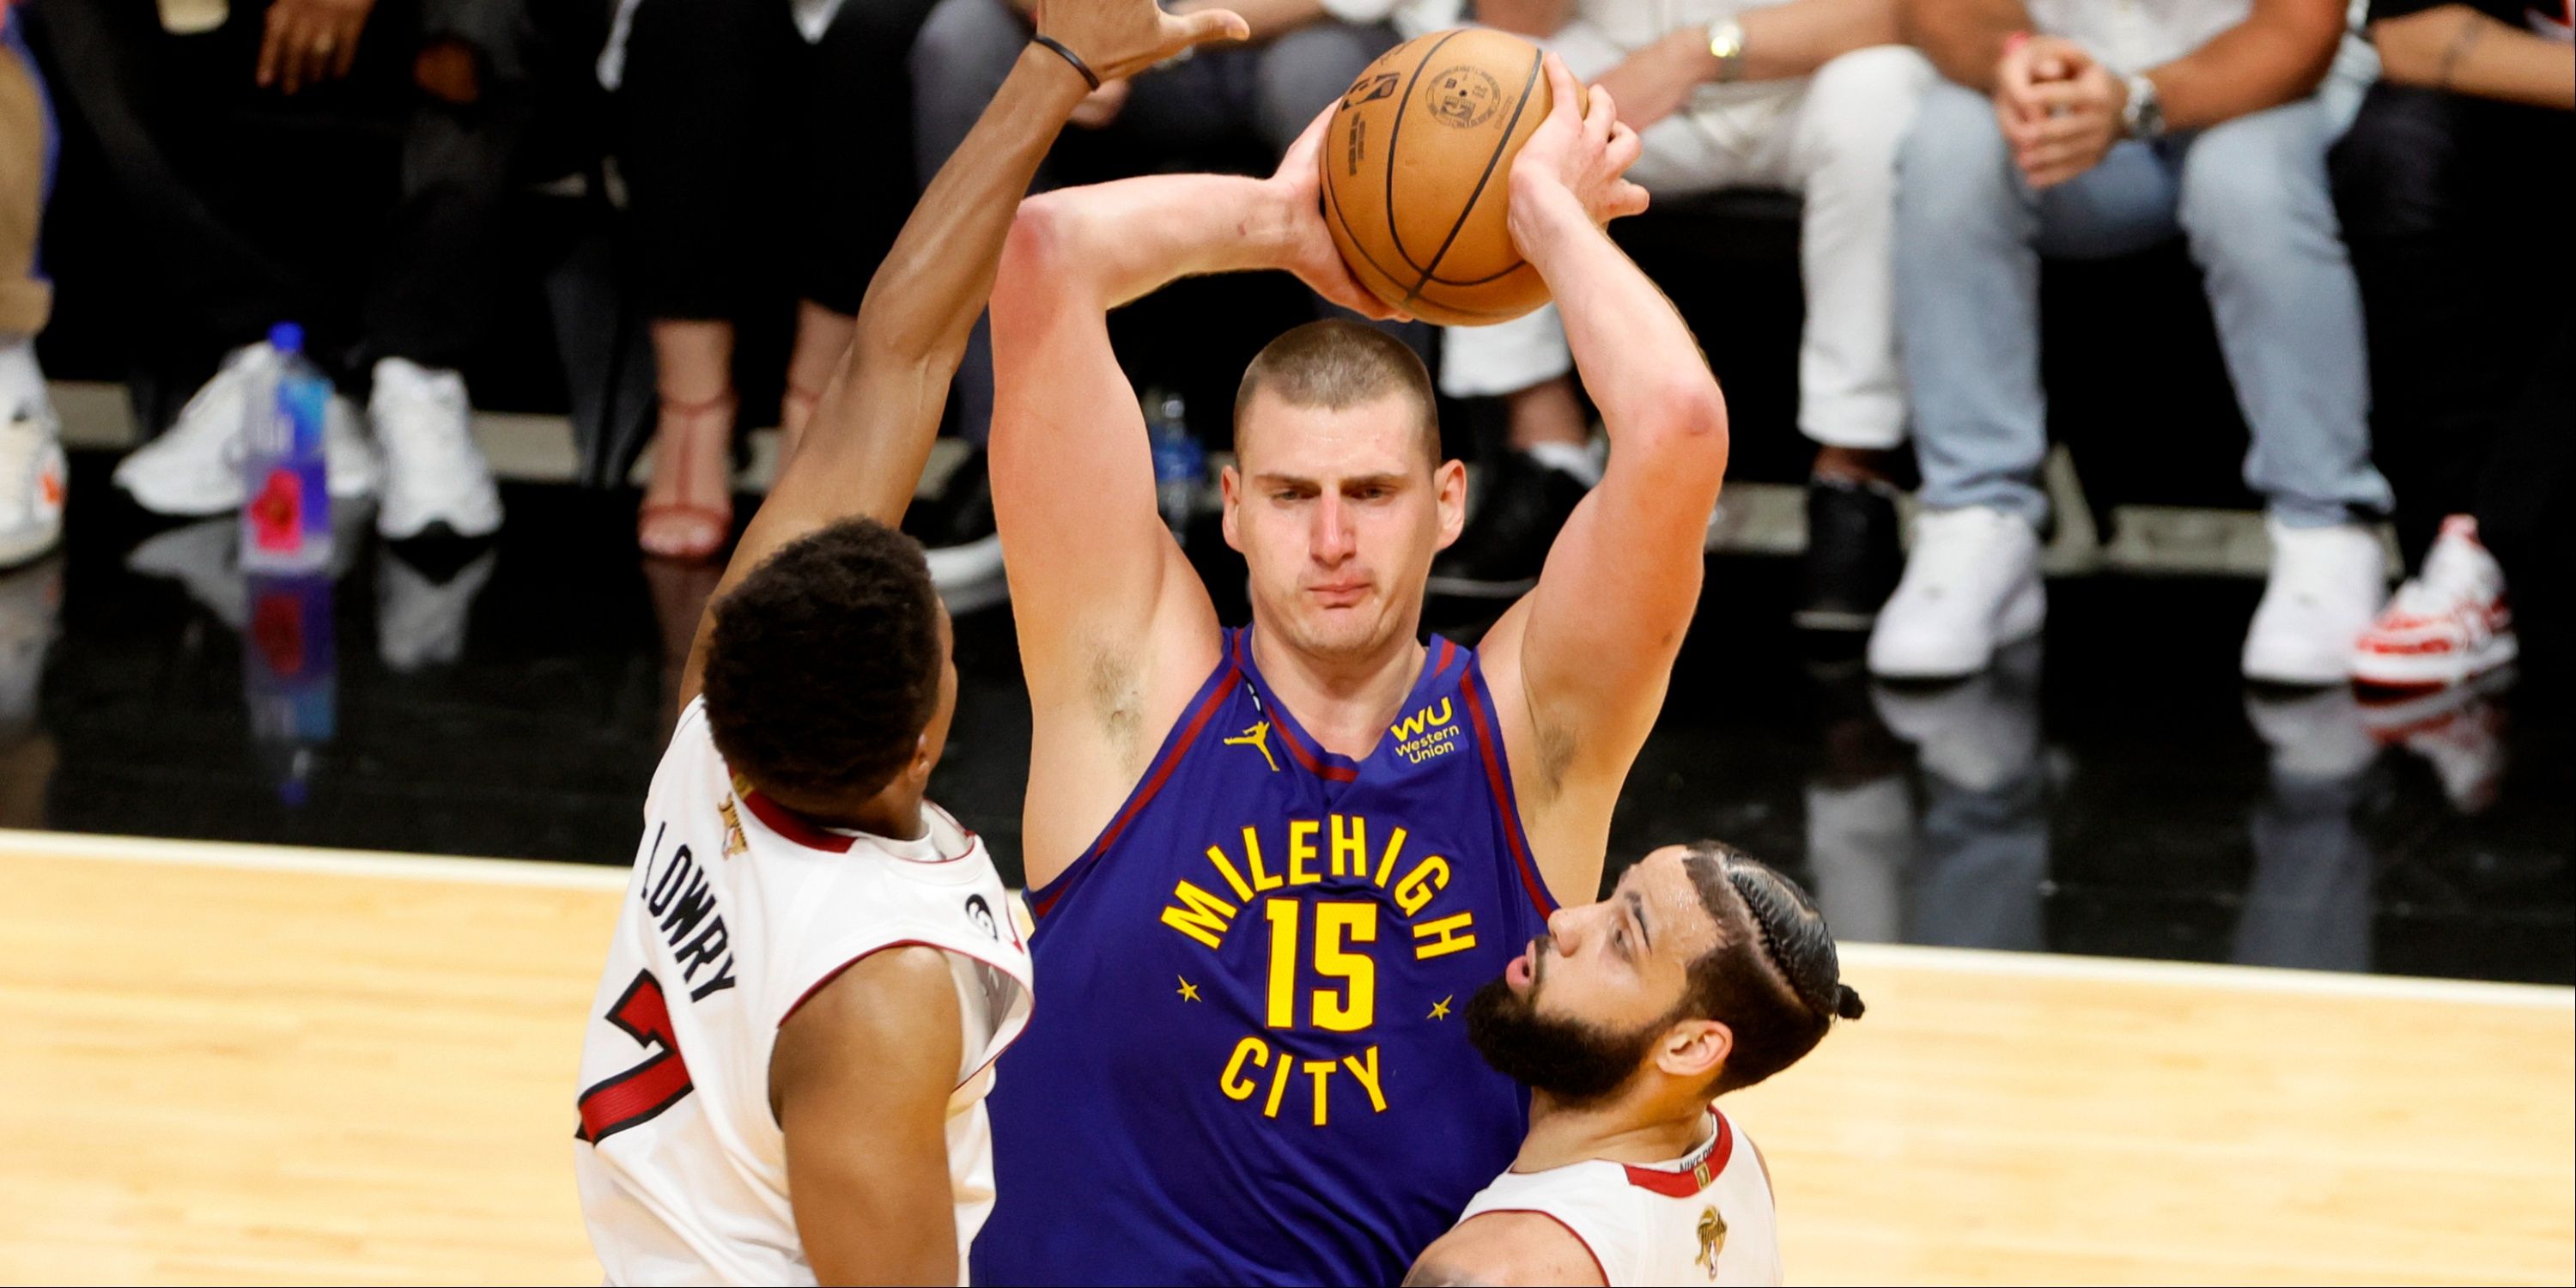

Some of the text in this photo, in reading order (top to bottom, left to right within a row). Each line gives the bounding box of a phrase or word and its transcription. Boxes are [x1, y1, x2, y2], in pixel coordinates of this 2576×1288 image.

[1390, 696, 1453, 742] WU
[1394, 725, 1460, 756] Western
[1409, 741, 1455, 764] Union
[641, 820, 736, 1003] LOWRY
[1265, 897, 1378, 1032] 15
[574, 968, 695, 1147] 7
[1219, 1036, 1388, 1126] CITY
